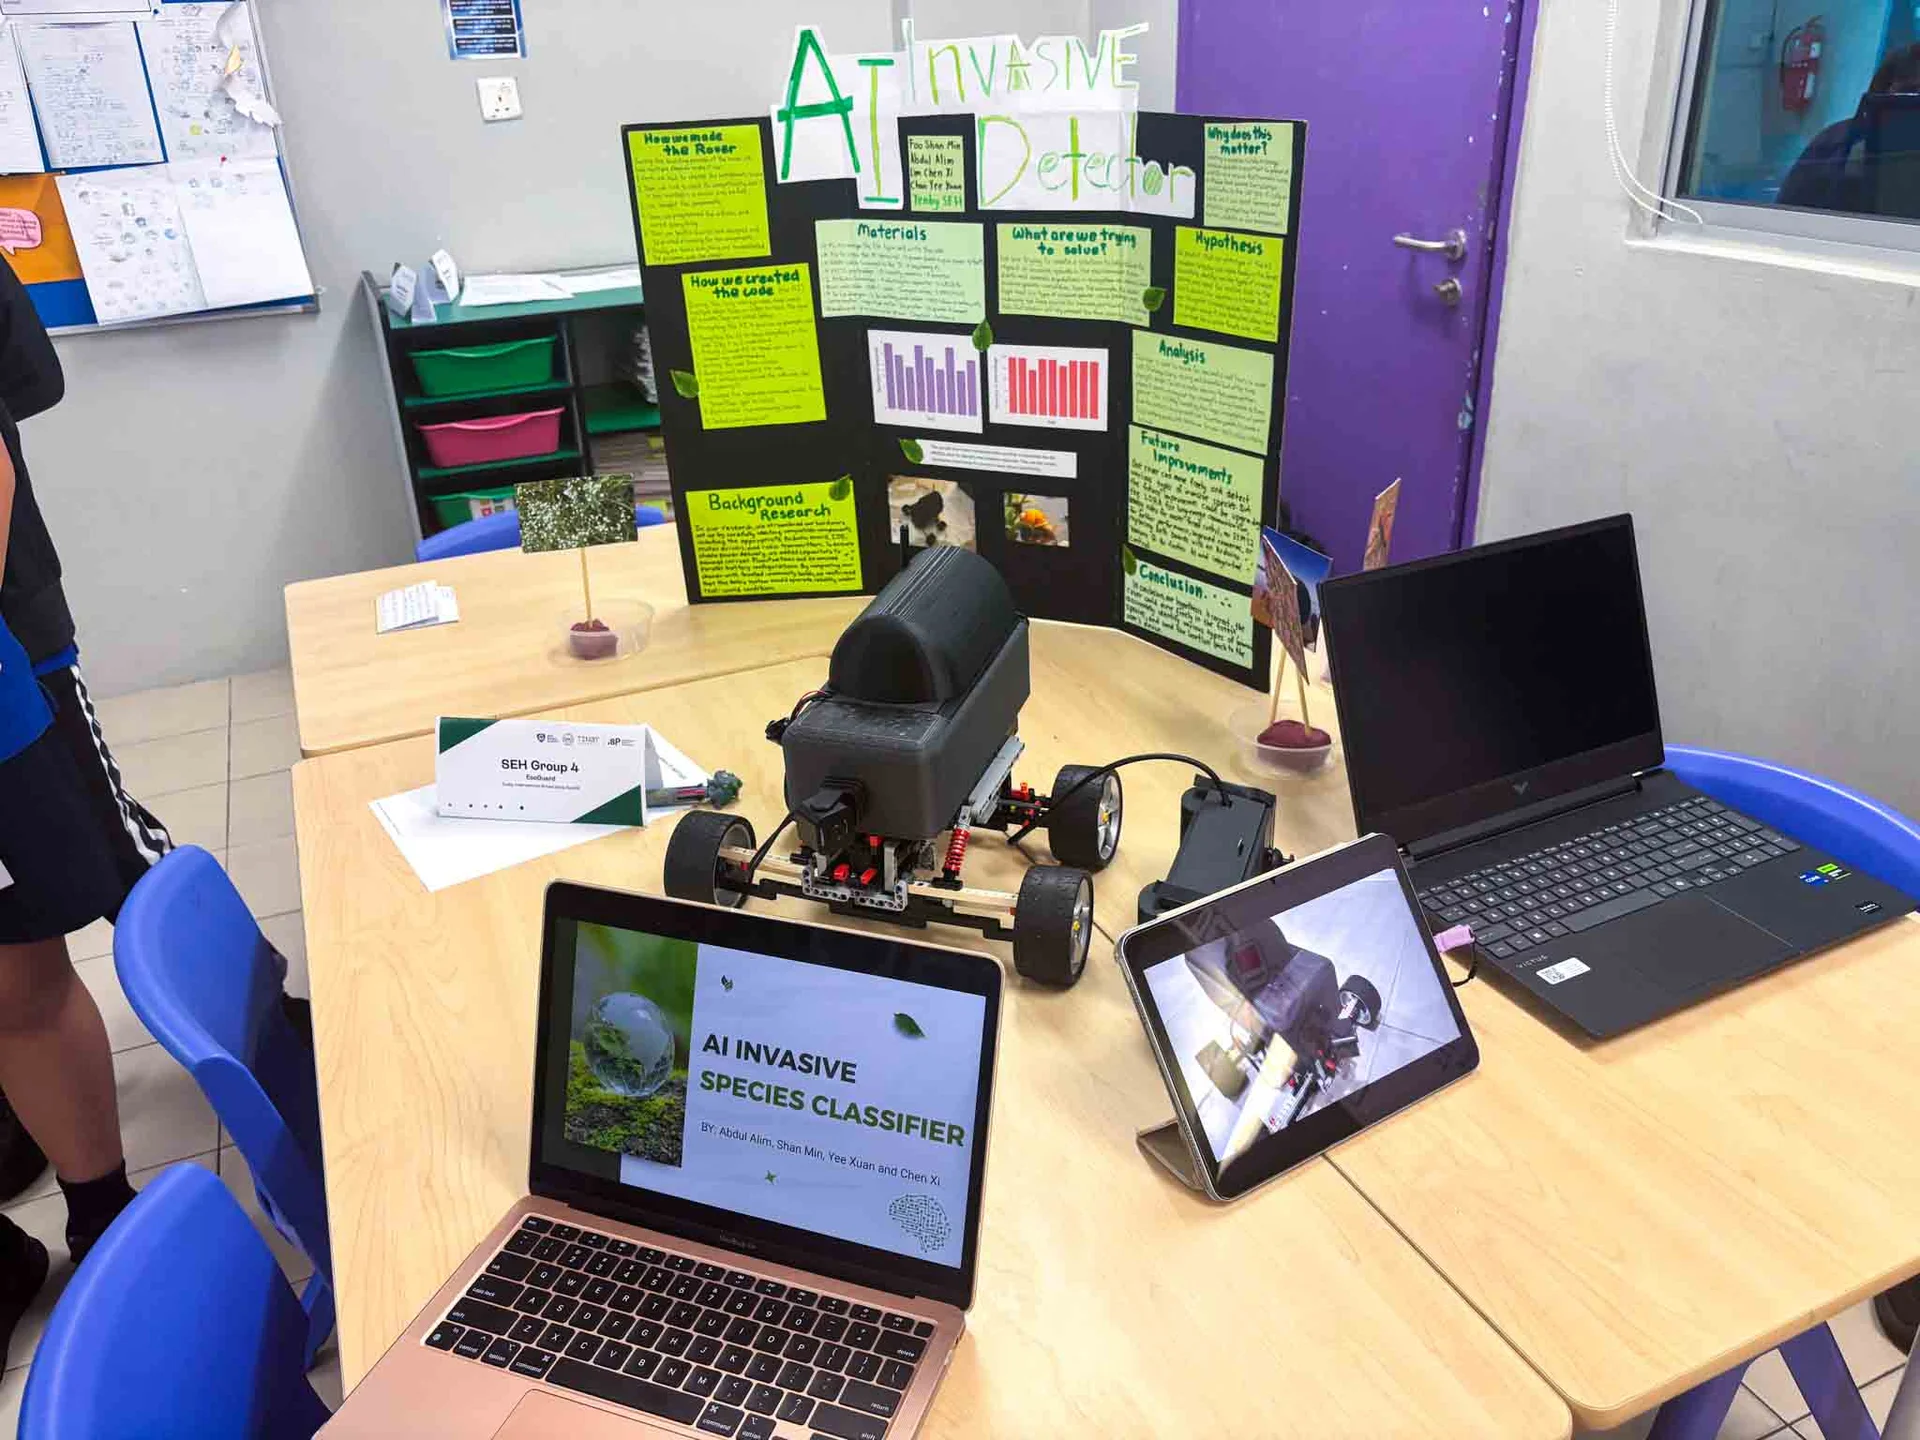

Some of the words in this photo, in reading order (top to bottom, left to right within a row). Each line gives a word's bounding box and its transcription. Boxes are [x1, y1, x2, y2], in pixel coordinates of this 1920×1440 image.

[1207, 127, 1229, 144] Why
[1230, 124, 1252, 140] does
[1252, 125, 1272, 142] this
[663, 145, 689, 156] the
[695, 143, 737, 155] Rover
[977, 111, 1195, 207] Detector
[1220, 141, 1268, 157] matter?
[857, 223, 927, 241] Materials
[1012, 227, 1048, 241] What
[1050, 230, 1074, 242] are
[1076, 231, 1097, 242] we
[1100, 228, 1137, 249] trying
[1195, 230, 1263, 256] Hypothesis
[1037, 242, 1054, 256] to
[1064, 242, 1107, 256] solve?
[690, 275, 718, 288] How
[722, 275, 743, 286] we
[745, 269, 800, 285] created
[712, 286, 739, 299] the
[743, 285, 774, 297] code
[1158, 339, 1205, 364] Analysis
[1141, 430, 1180, 452] Future
[1153, 448, 1233, 485] Improvements
[708, 491, 804, 514] Background
[761, 503, 831, 521] Research
[501, 759, 527, 770] SEH
[531, 760, 568, 774] Group
[570, 762, 579, 773] 4
[702, 1034, 728, 1056] AI
[735, 1038, 857, 1084] INVASIVE
[700, 1070, 805, 1111] SPECIES
[811, 1095, 966, 1147] CLASSIFIER
[701, 1121, 718, 1134] BY:
[719, 1127, 748, 1141] Abdul
[749, 1133, 775, 1149] Alim,
[776, 1140, 802, 1154] Shan
[804, 1146, 826, 1162] Min,
[828, 1152, 847, 1165] Yee
[849, 1156, 876, 1171] Xuan
[878, 1162, 898, 1177] and
[900, 1168, 928, 1184] Chen
[930, 1175, 941, 1186] Xi
[569, 1255, 577, 1263] 2
[595, 1263, 604, 1271] 3
[650, 1278, 658, 1286] 5
[678, 1286, 686, 1294] 6
[735, 1302, 744, 1310] 8
[765, 1310, 773, 1318] 9
[795, 1318, 803, 1326] 0
[540, 1271, 548, 1279] Q
[567, 1278, 577, 1287] W
[594, 1286, 602, 1294] E
[622, 1294, 630, 1302] R
[652, 1302, 659, 1310] T
[707, 1319, 717, 1327] U
[767, 1335, 776, 1344] O
[796, 1343, 805, 1351] P
[528, 1296, 536, 1304] A
[556, 1304, 564, 1312] S
[583, 1312, 592, 1320] D
[641, 1328, 649, 1337] G
[669, 1337, 679, 1345] H
[699, 1346, 708, 1354] J
[729, 1354, 737, 1363] K
[523, 1325, 532, 1333] Z
[551, 1332, 560, 1341] X
[579, 1341, 588, 1350] C
[610, 1349, 618, 1358] V
[638, 1358, 646, 1367] B
[667, 1367, 677, 1376] N
[697, 1376, 708, 1385] M
[702, 1418, 731, 1430] command
[741, 1430, 761, 1439] option
